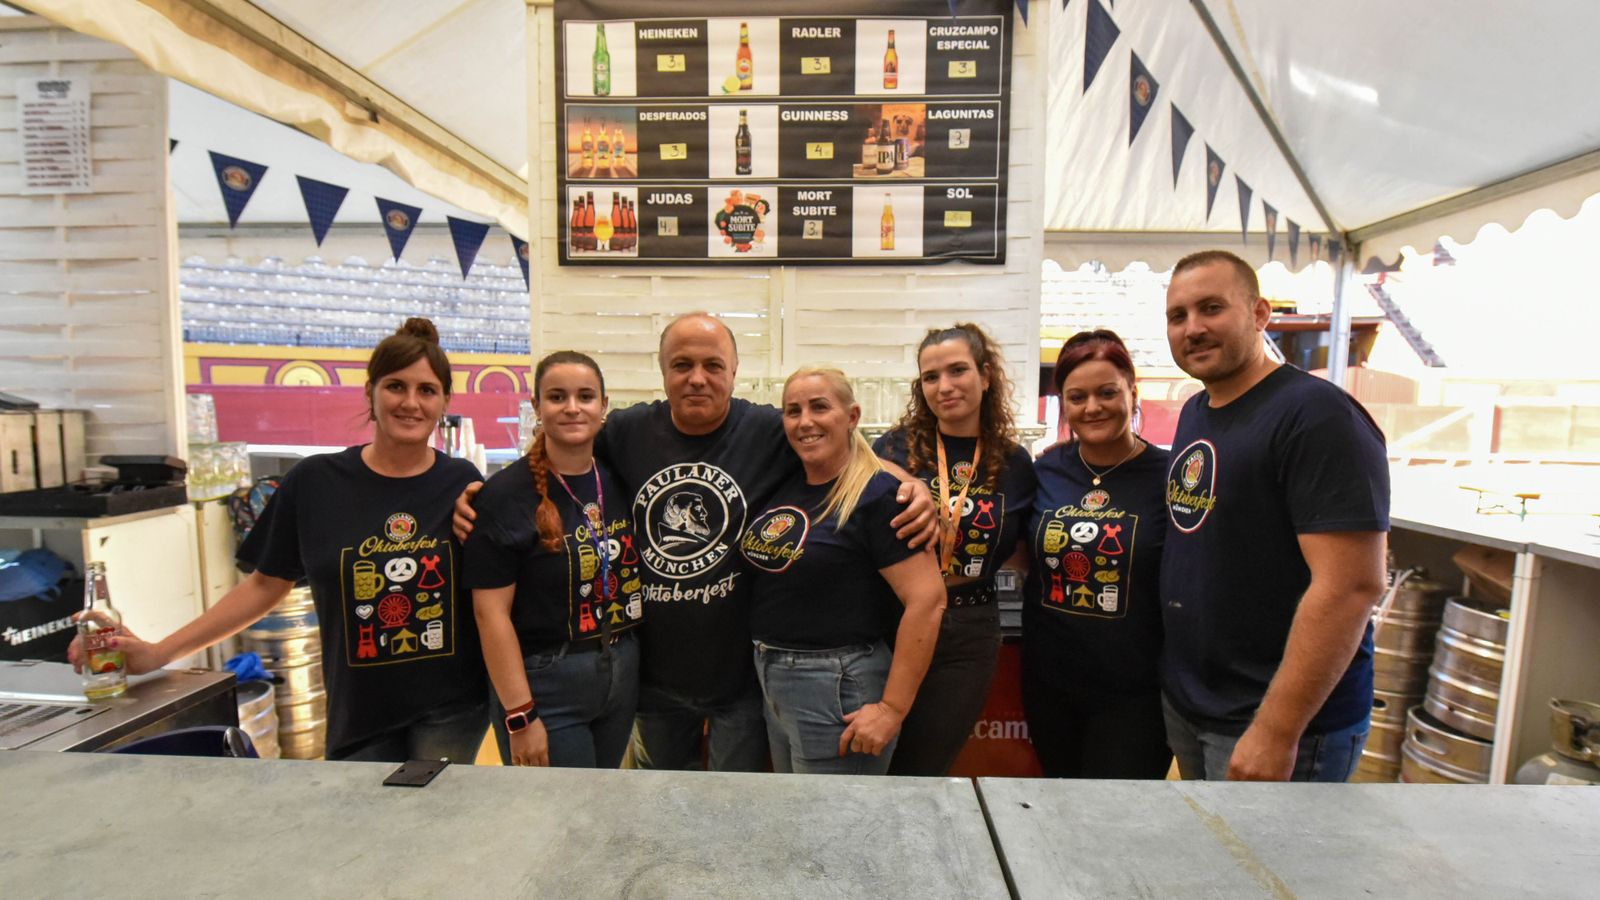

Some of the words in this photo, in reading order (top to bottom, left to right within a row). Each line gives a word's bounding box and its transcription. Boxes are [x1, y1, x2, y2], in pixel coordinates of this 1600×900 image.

[639, 28, 698, 39] HEINEKEN
[792, 27, 841, 38] RADLER
[929, 26, 998, 36] CRUZCAMPO
[937, 40, 990, 50] ESPECIAL
[639, 111, 706, 121] DESPERADOS
[781, 110, 848, 121] GUINNESS
[928, 109, 994, 119] LAGUNITAS
[878, 151, 894, 163] IPA
[647, 194, 693, 204] JUDAS
[797, 191, 832, 201] MORT
[946, 188, 973, 199] SOL
[792, 206, 837, 216] SUBITE
[730, 215, 754, 223] MORT
[728, 223, 755, 232] SUBITE
[637, 465, 738, 507] PAULANER
[1055, 505, 1125, 520] Oktoberfest
[358, 535, 437, 557] Oktoberfest
[743, 531, 804, 560] Oktoberfest
[643, 542, 729, 574] MÜNCHEN
[642, 572, 742, 605] Oktoberfest
